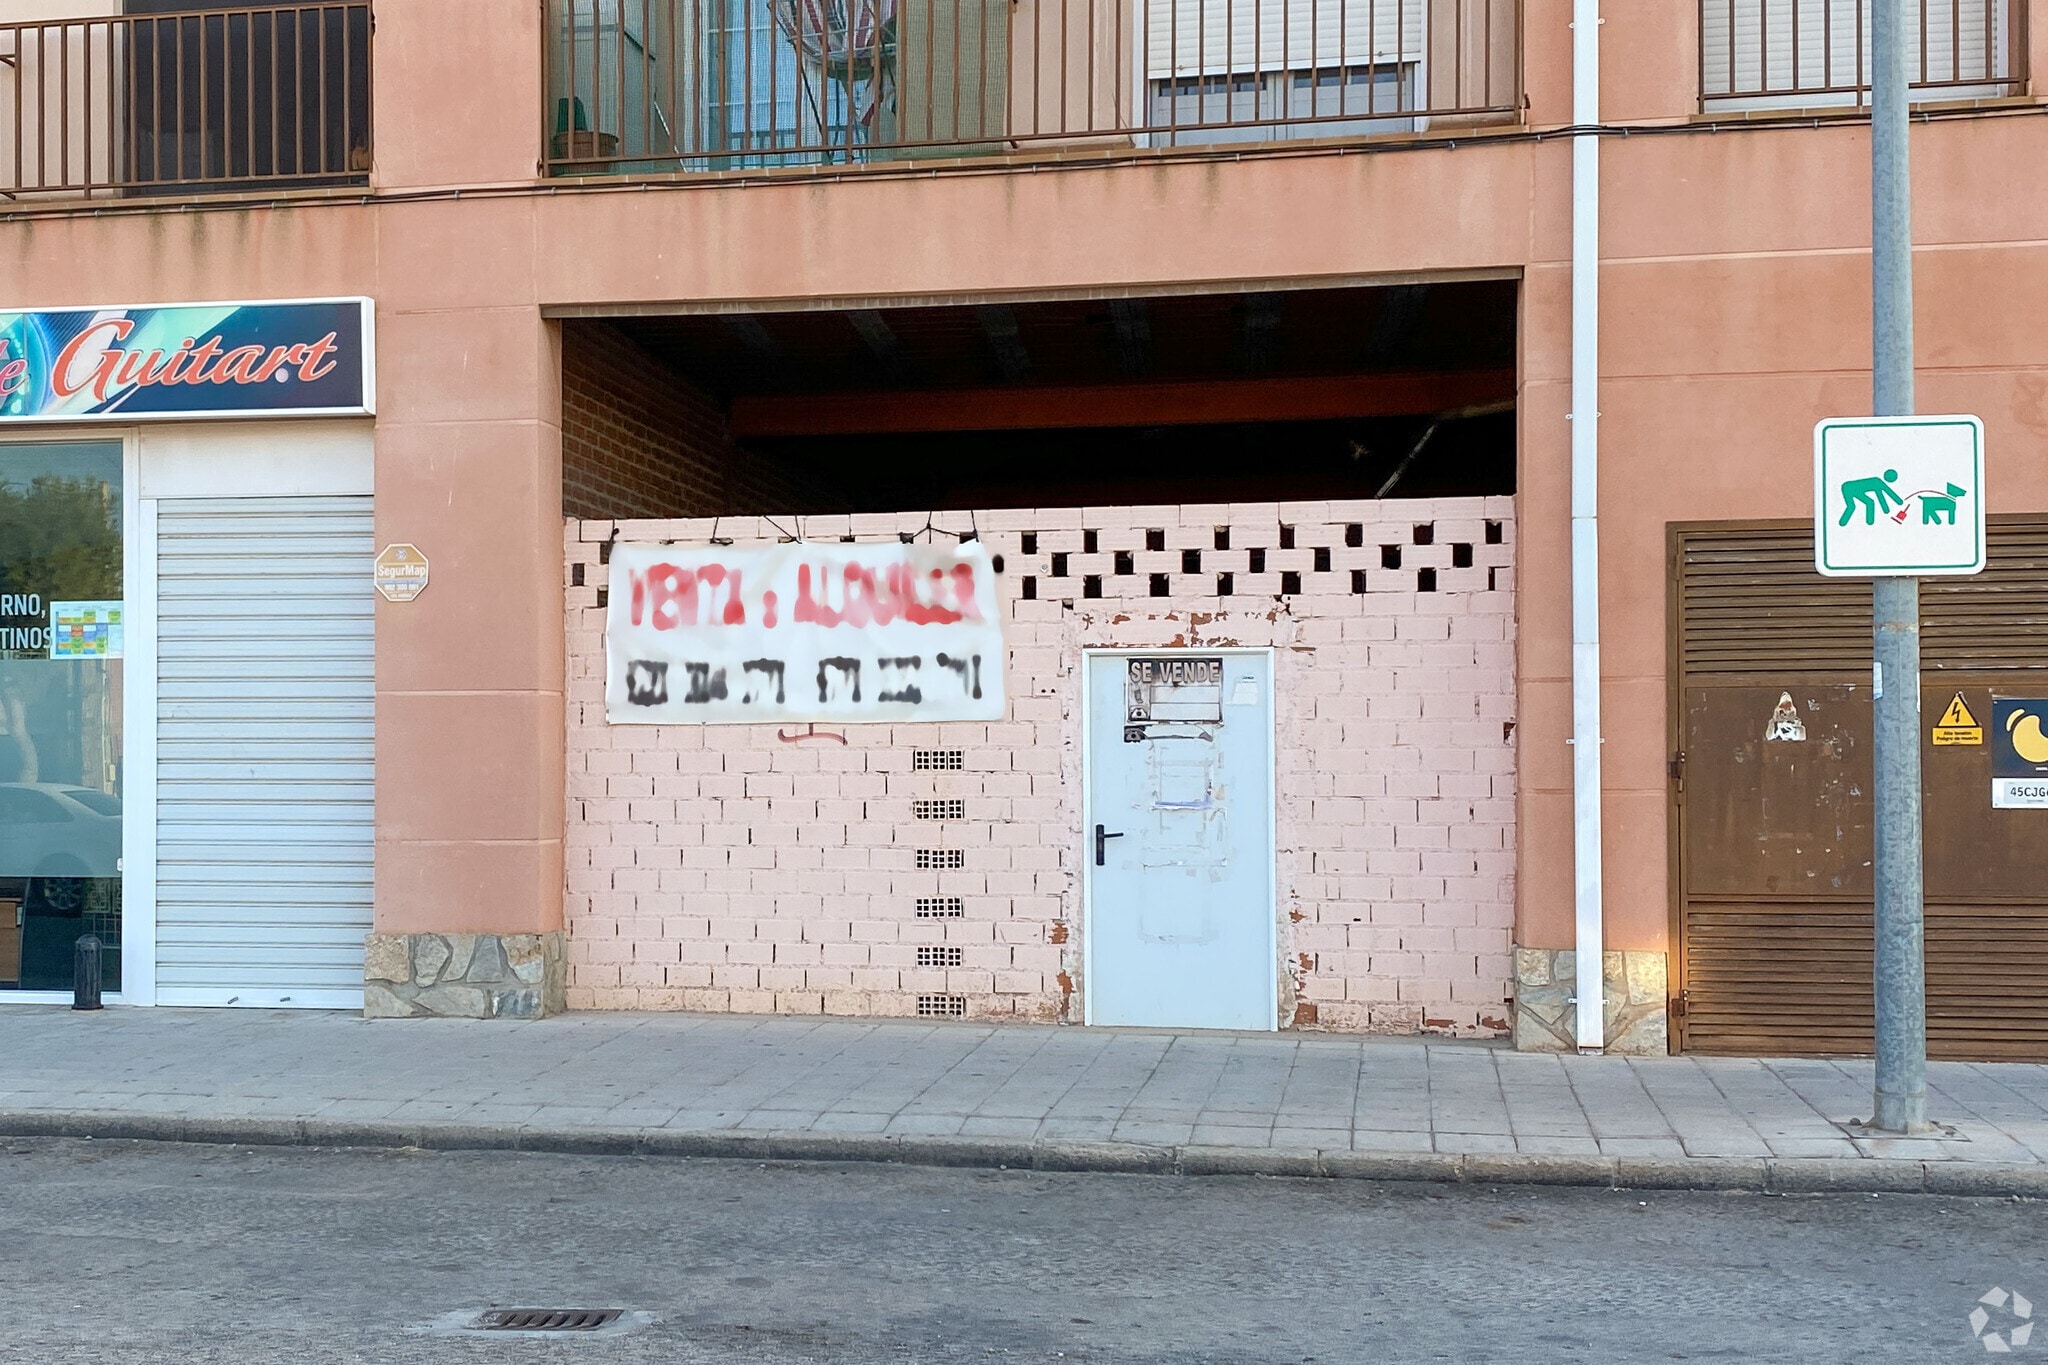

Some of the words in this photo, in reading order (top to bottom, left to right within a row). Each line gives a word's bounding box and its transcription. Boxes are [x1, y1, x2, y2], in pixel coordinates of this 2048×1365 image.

[52, 320, 337, 402] Guitart
[378, 565, 426, 578] SegurMap
[1131, 661, 1152, 682] SE
[1159, 661, 1220, 682] VENDE
